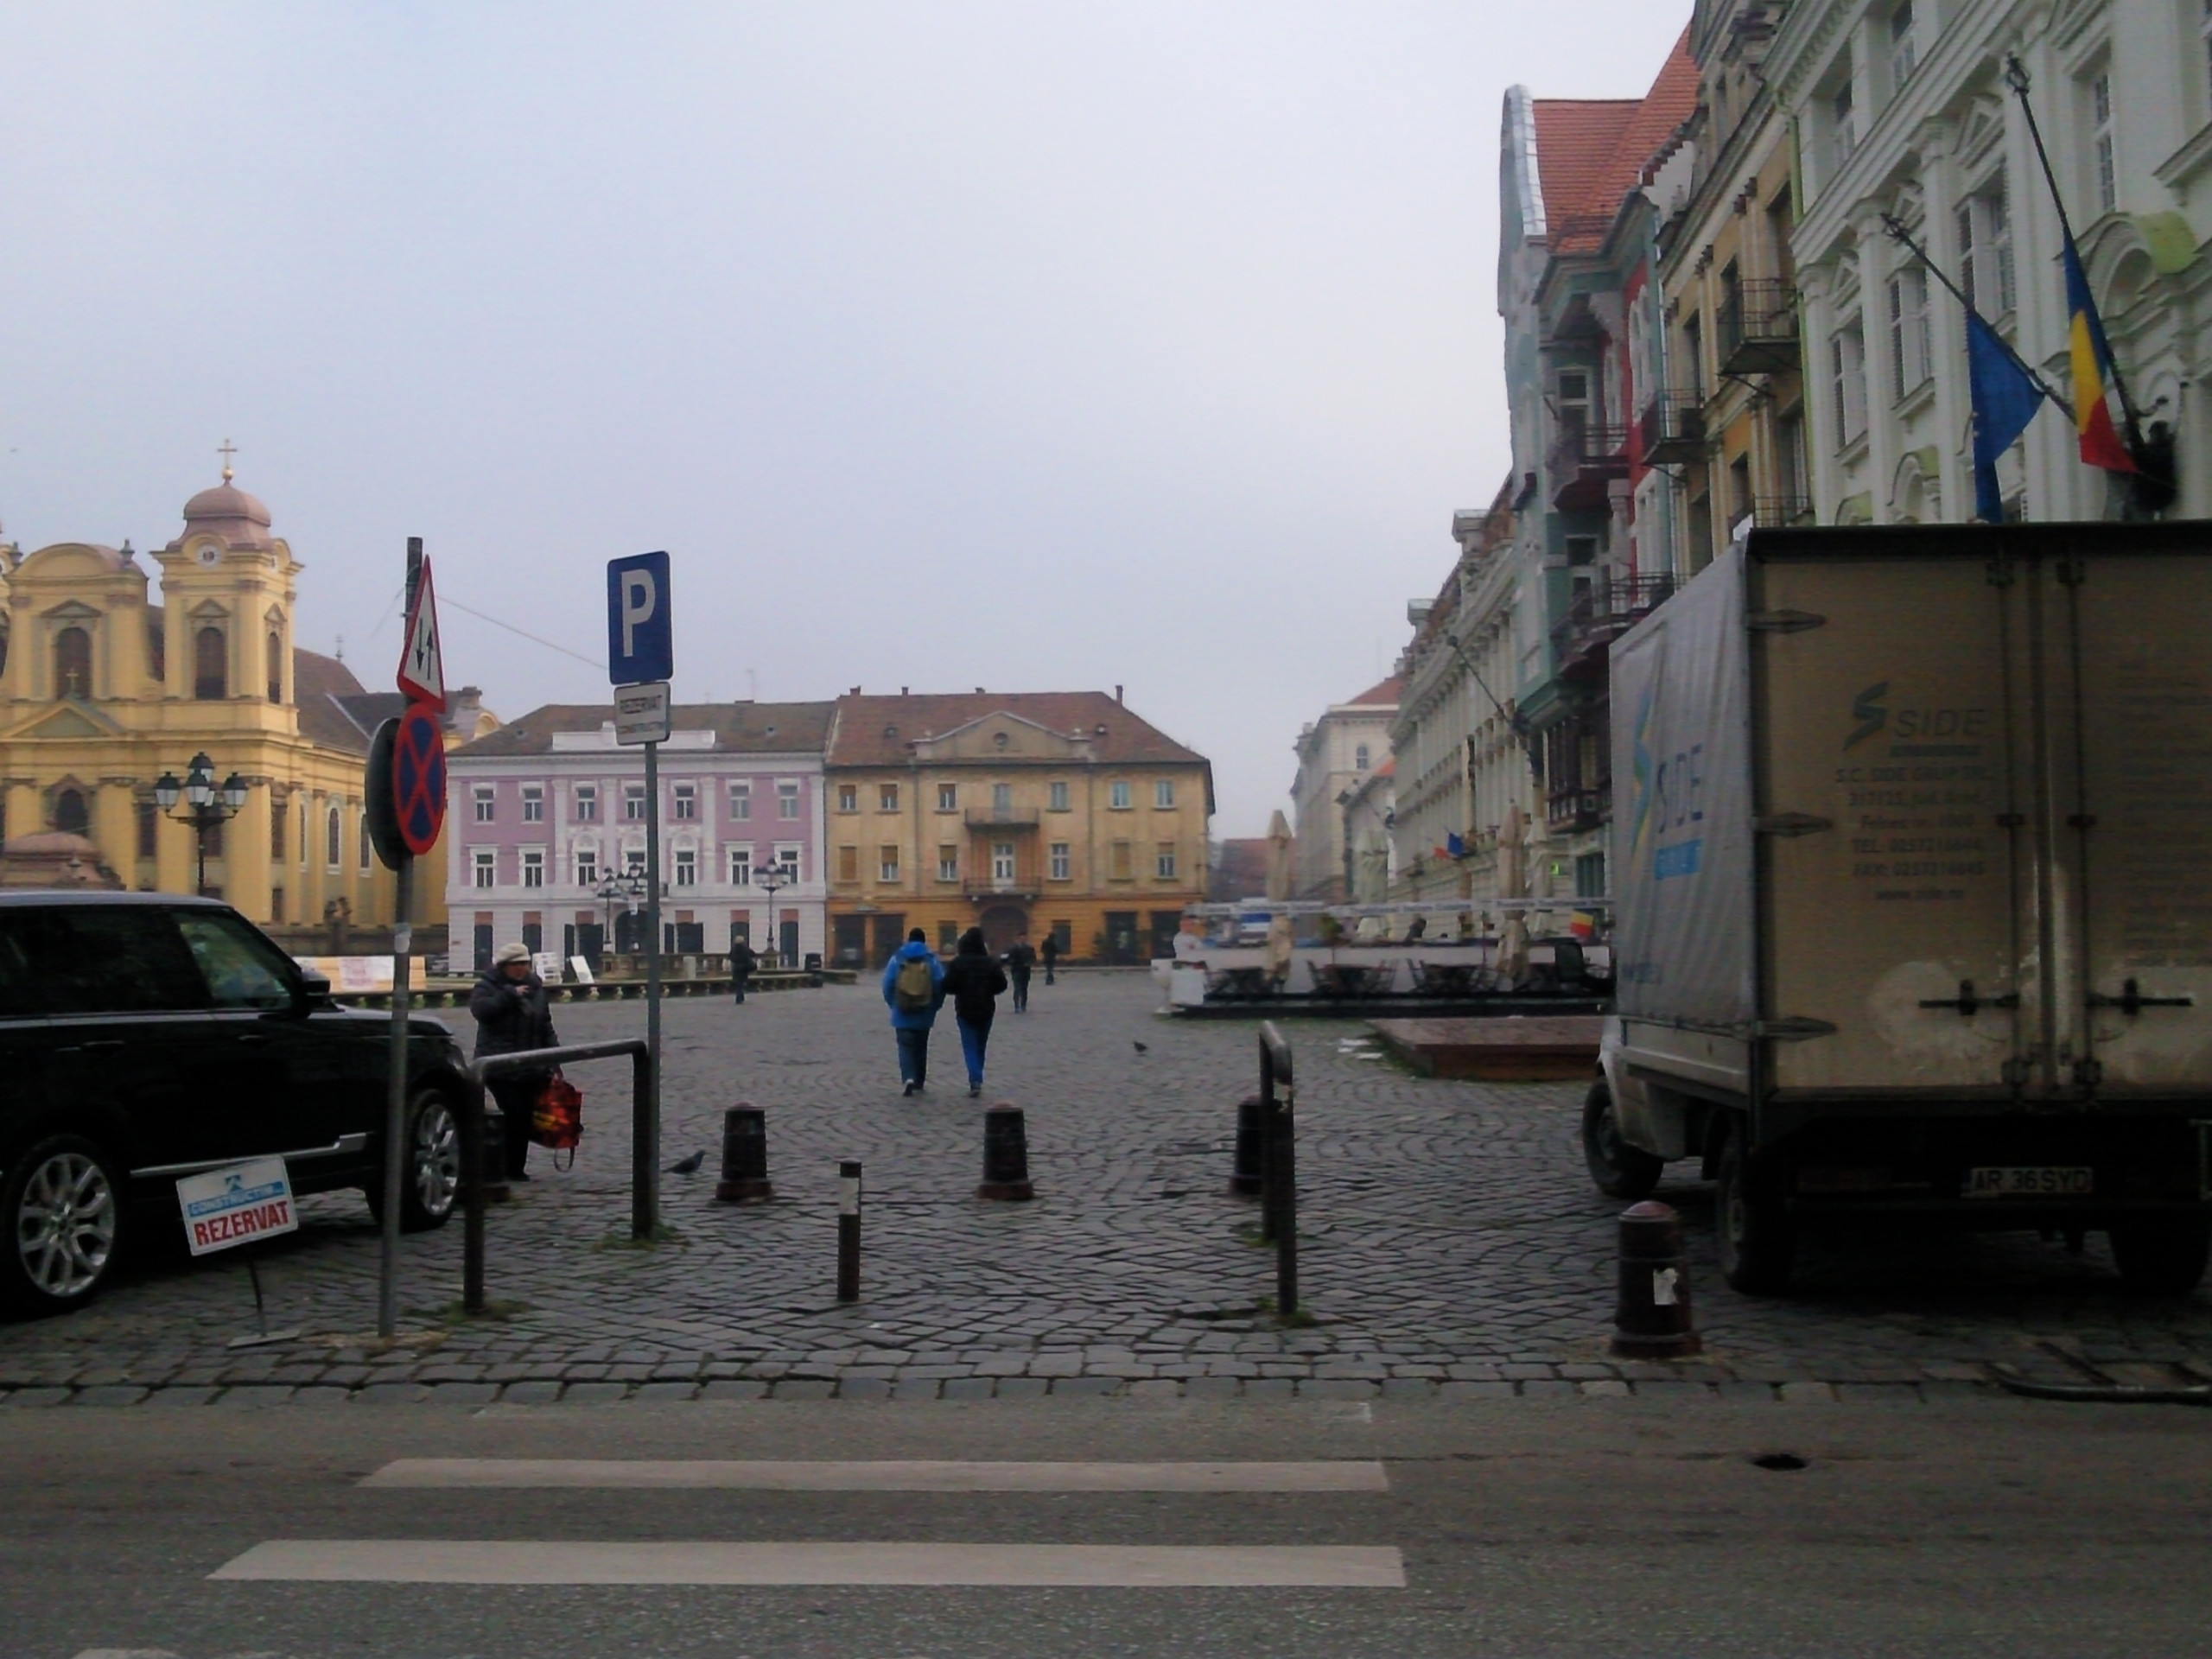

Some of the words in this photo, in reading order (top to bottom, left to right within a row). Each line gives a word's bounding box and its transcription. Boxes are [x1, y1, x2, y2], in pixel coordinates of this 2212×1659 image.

[620, 569, 656, 657] P
[1894, 709, 1988, 737] SIDE
[1976, 1169, 2001, 1190] AR
[2012, 1169, 2037, 1190] 36
[194, 1200, 289, 1246] REZERVAT
